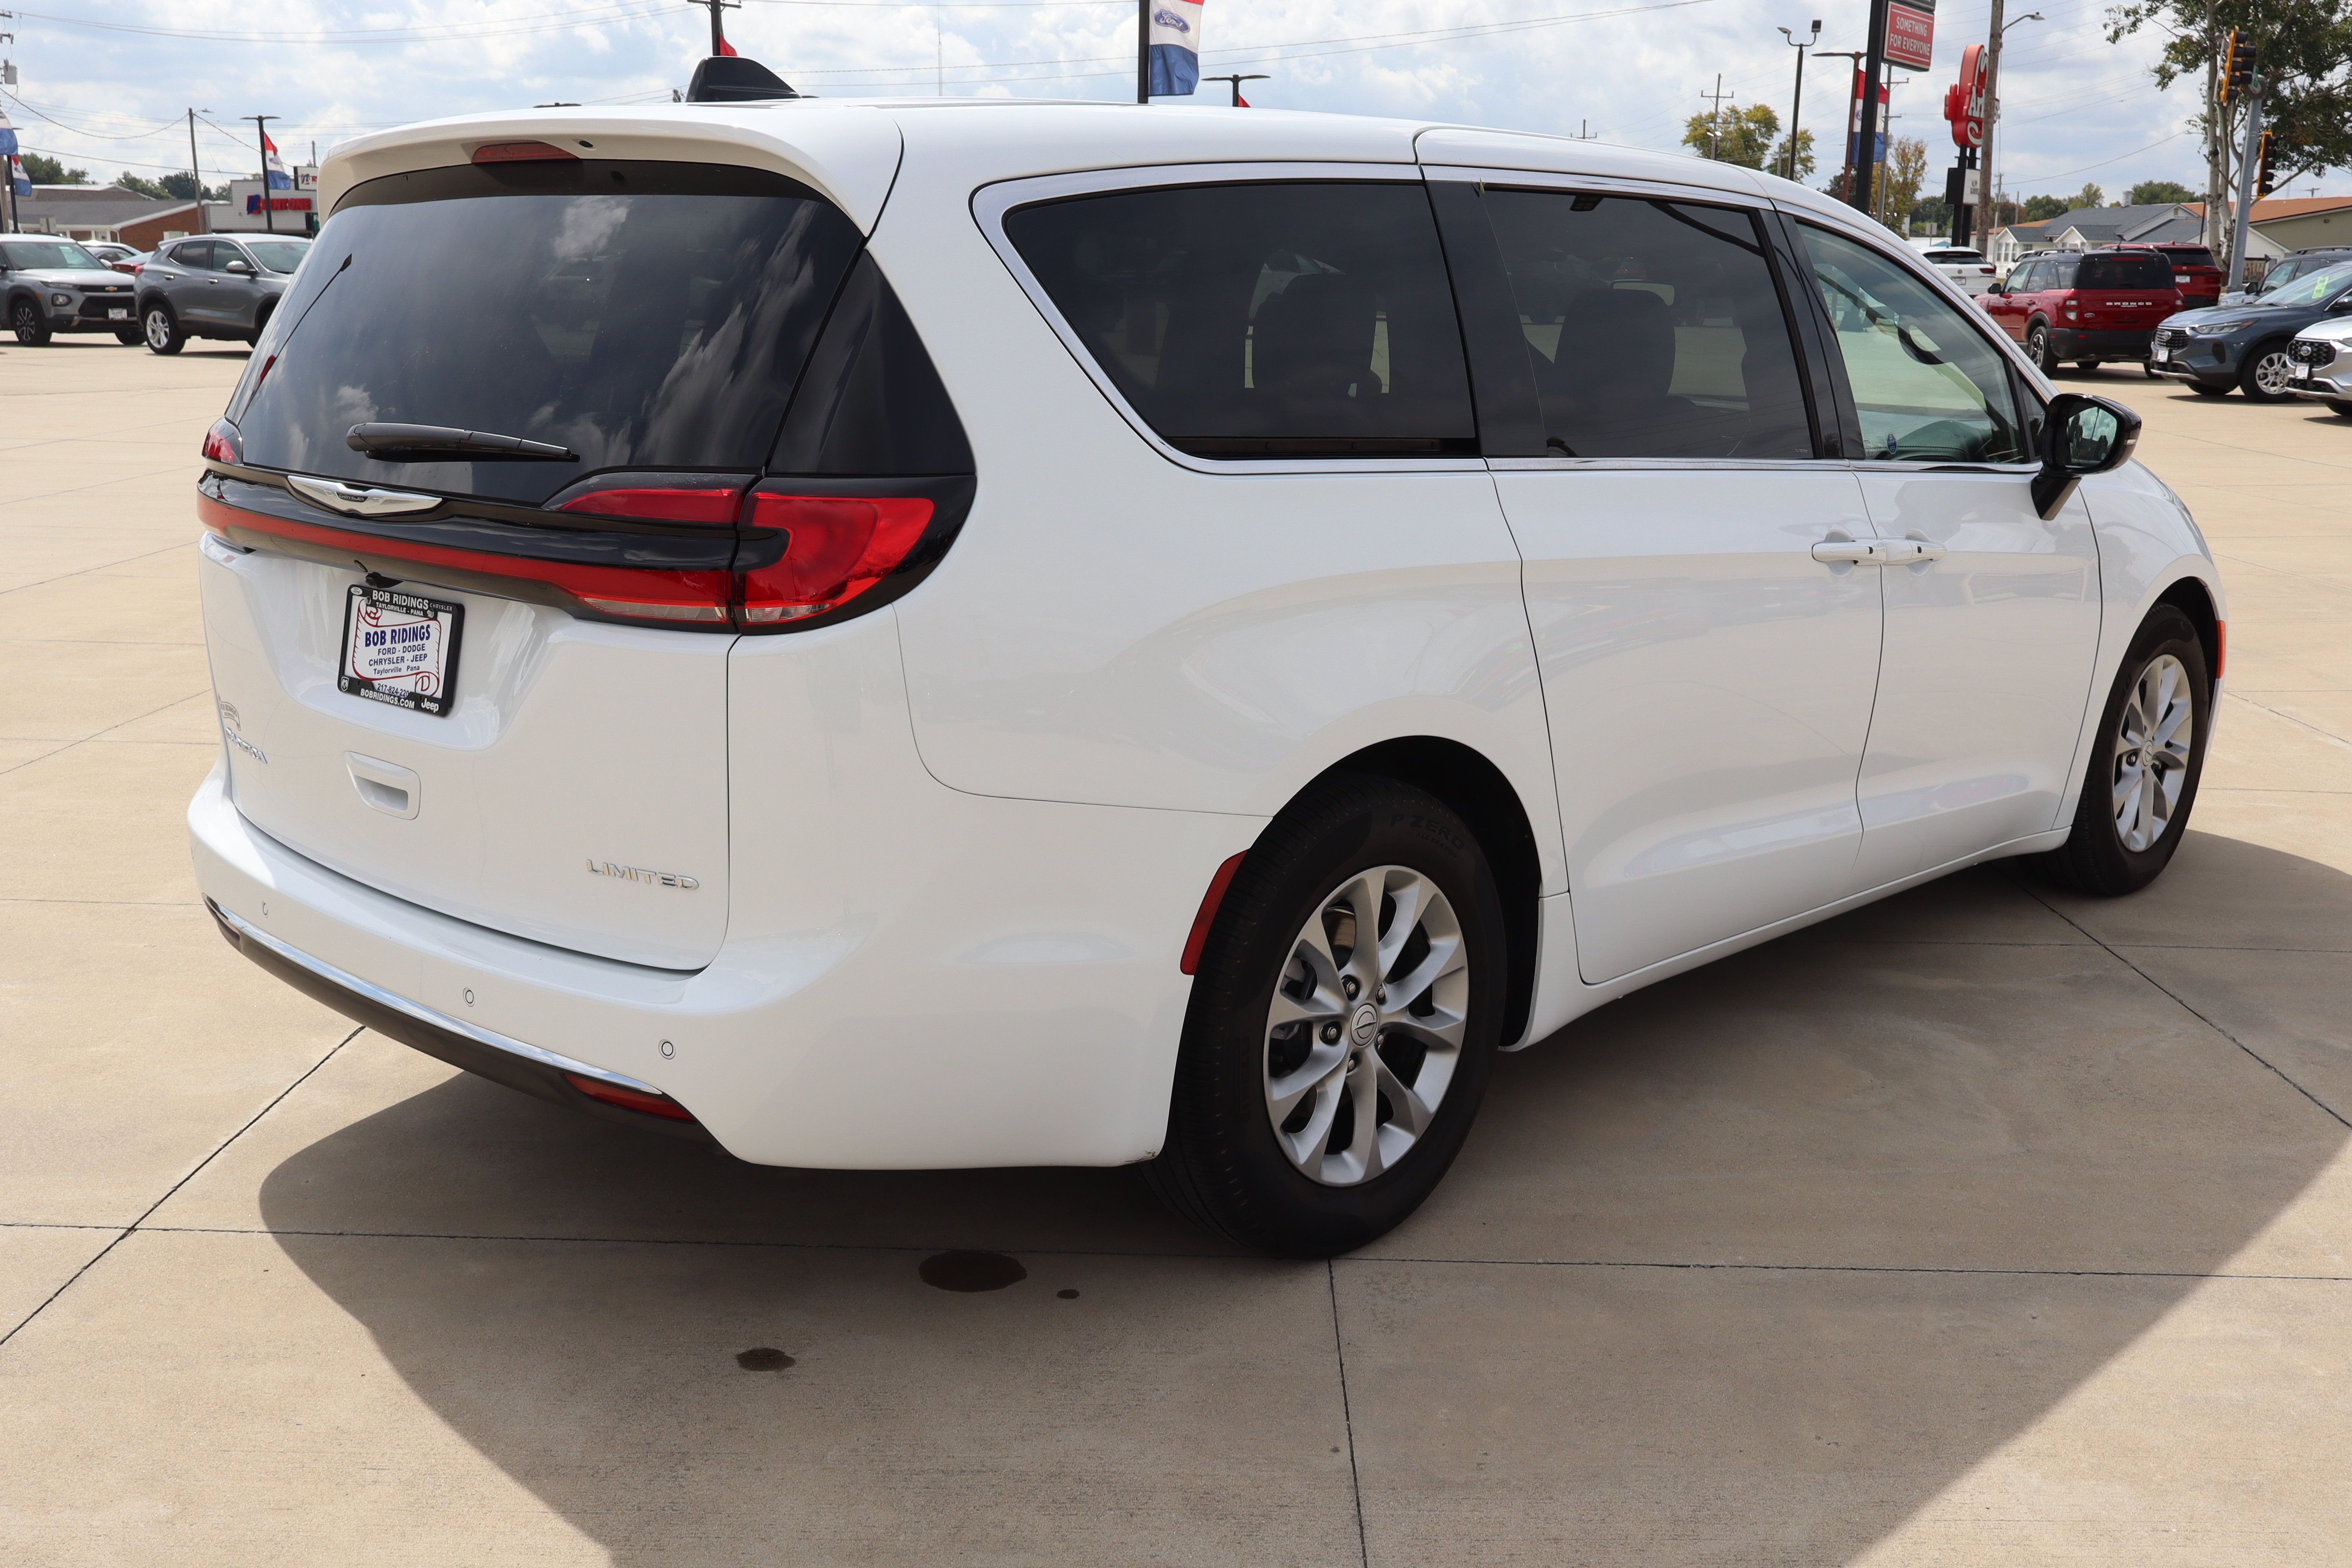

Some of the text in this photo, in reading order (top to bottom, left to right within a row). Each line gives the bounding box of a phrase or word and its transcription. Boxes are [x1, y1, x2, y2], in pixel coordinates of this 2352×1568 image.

[1896, 16, 1928, 37] SOMETHING
[1889, 33, 1931, 56] FOR EVERYONE
[372, 590, 453, 612] BOB RIDINGS CHRYSLER
[376, 601, 407, 613] TAYLORVILLE
[365, 624, 430, 648] BOB RIDINGS
[369, 656, 405, 666] CHRYSLER
[411, 653, 428, 662] JEEP
[378, 647, 396, 656] FORD
[402, 643, 425, 653] DODGE
[374, 666, 402, 676] Taylorville
[360, 688, 439, 713] BOBRIDINGS.COM Jeep
[377, 683, 410, 697] 217-824-220
[1389, 813, 1464, 850] P ZERO
[586, 859, 699, 890] LIMITED
